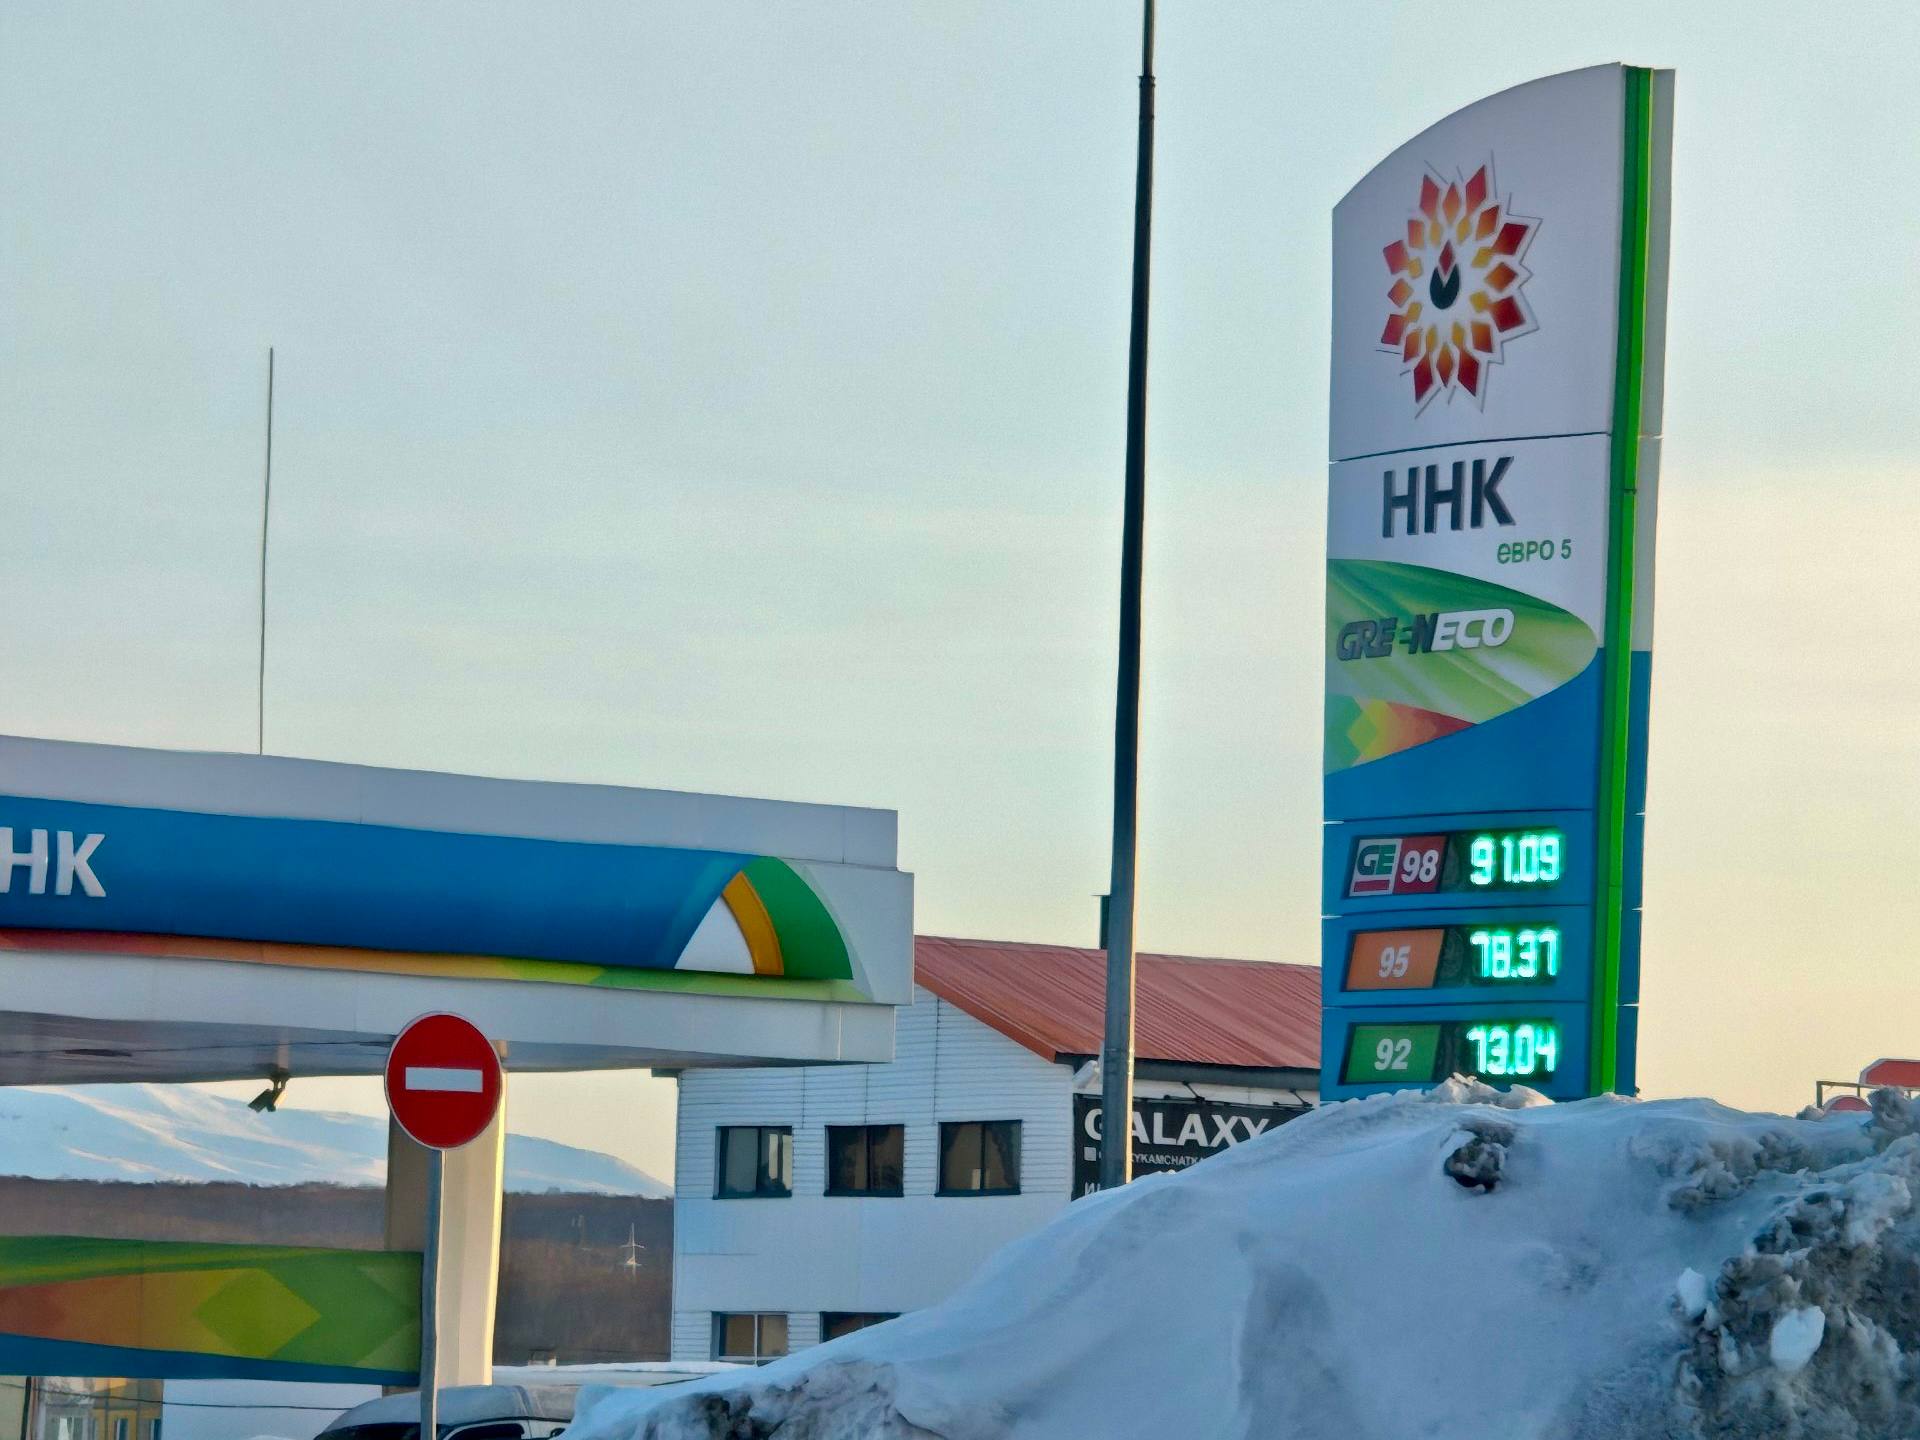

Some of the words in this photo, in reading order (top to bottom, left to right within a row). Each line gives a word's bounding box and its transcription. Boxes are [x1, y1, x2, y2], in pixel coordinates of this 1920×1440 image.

[1382, 456, 1516, 538] ННК
[1561, 538, 1572, 559] 5
[1357, 845, 1396, 875] GE
[1401, 849, 1438, 883] 98
[1470, 836, 1560, 885] 91.09
[1378, 945, 1411, 977] 95
[1470, 930, 1558, 978] 78.37
[1374, 1038, 1412, 1070] 92
[1467, 1024, 1556, 1074] 73.04
